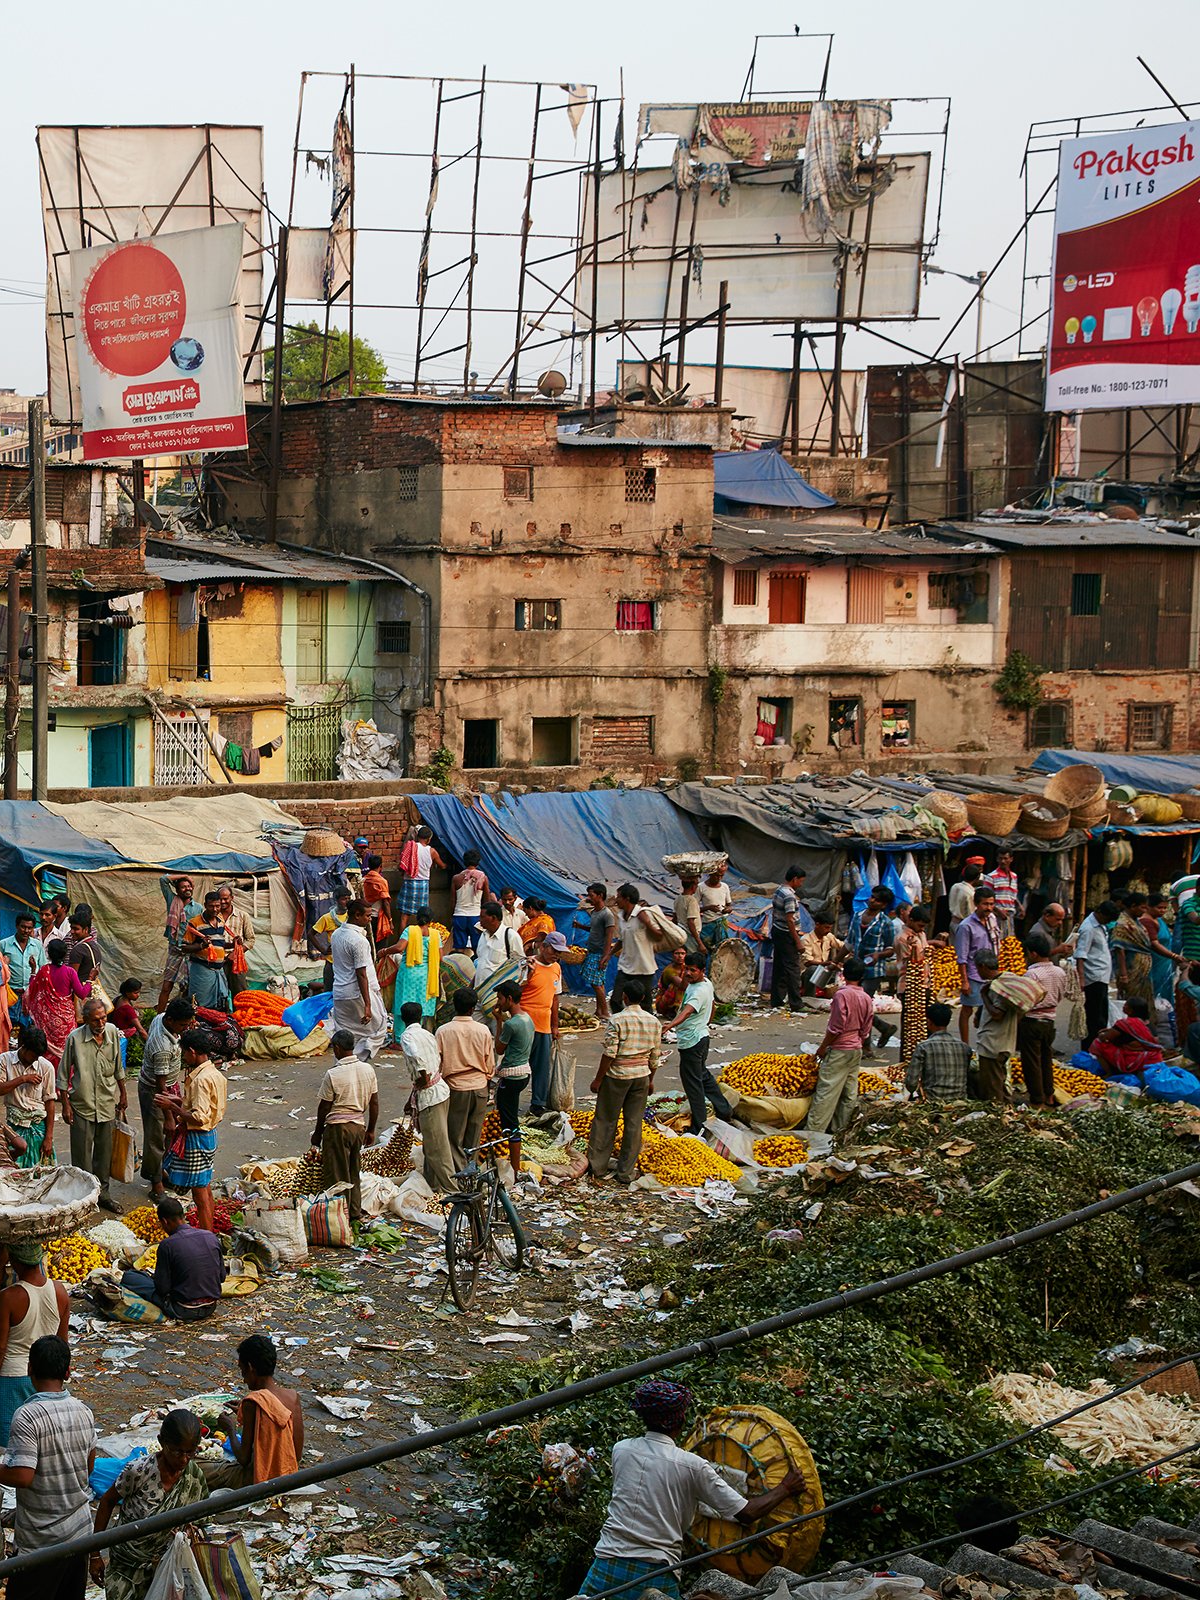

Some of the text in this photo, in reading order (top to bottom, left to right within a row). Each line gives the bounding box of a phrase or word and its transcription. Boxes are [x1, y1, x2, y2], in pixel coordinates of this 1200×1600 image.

[752, 103, 764, 114] in
[1073, 133, 1195, 180] Prakash
[1104, 180, 1155, 200] LITES
[1088, 272, 1115, 288] LED
[1058, 385, 1089, 396] Toll-free
[1109, 378, 1169, 392] 1800-123-7071
